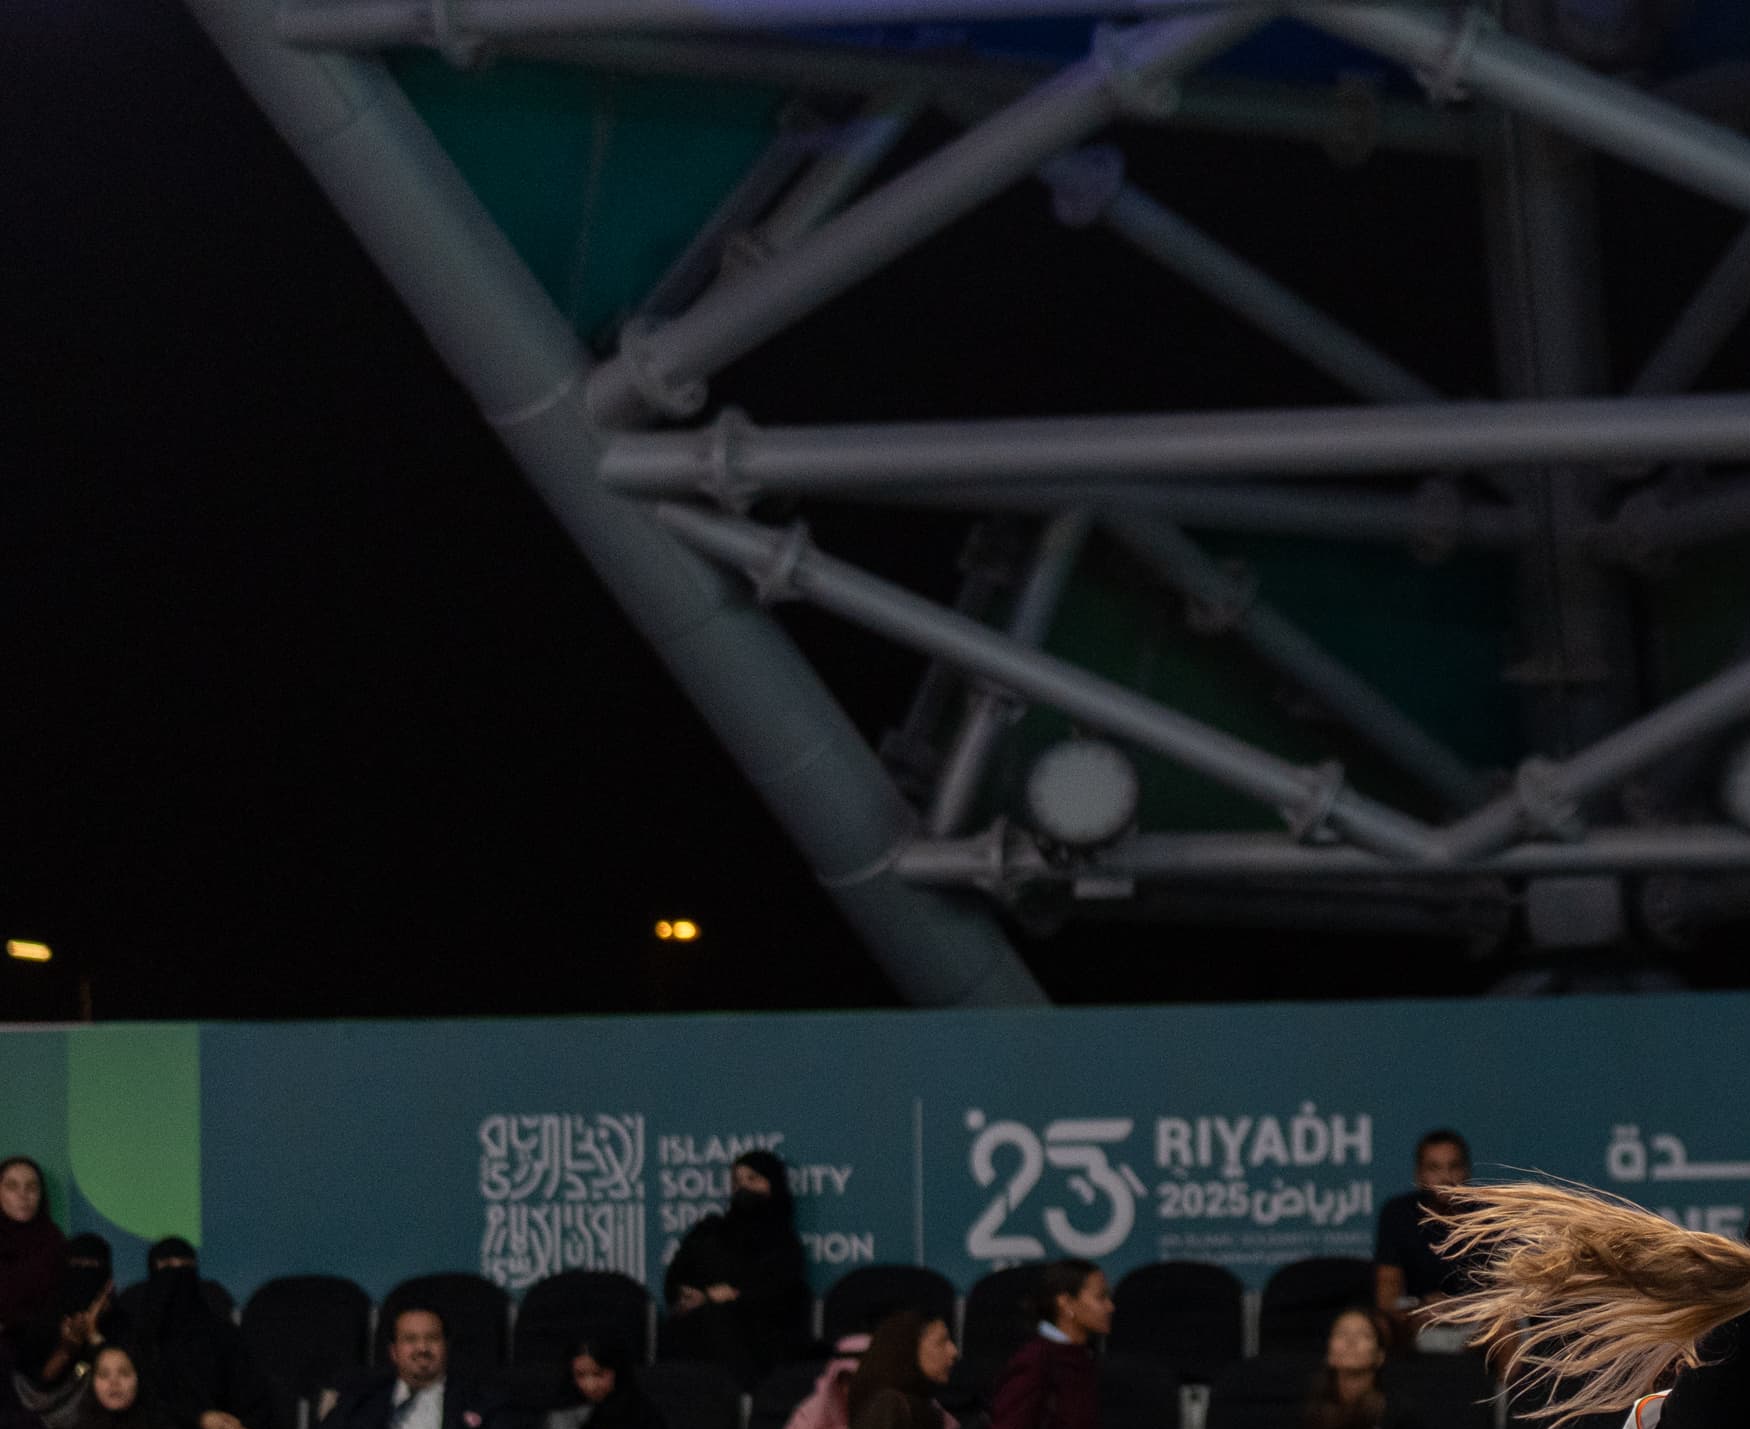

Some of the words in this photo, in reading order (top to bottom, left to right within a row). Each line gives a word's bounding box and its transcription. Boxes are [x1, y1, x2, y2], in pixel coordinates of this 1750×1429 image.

[1155, 1101, 1373, 1178] RIYADH
[659, 1164, 852, 1198] SOLIRITY
[1157, 1182, 1247, 1219] 2025
[1249, 1177, 1373, 1225] الرياض
